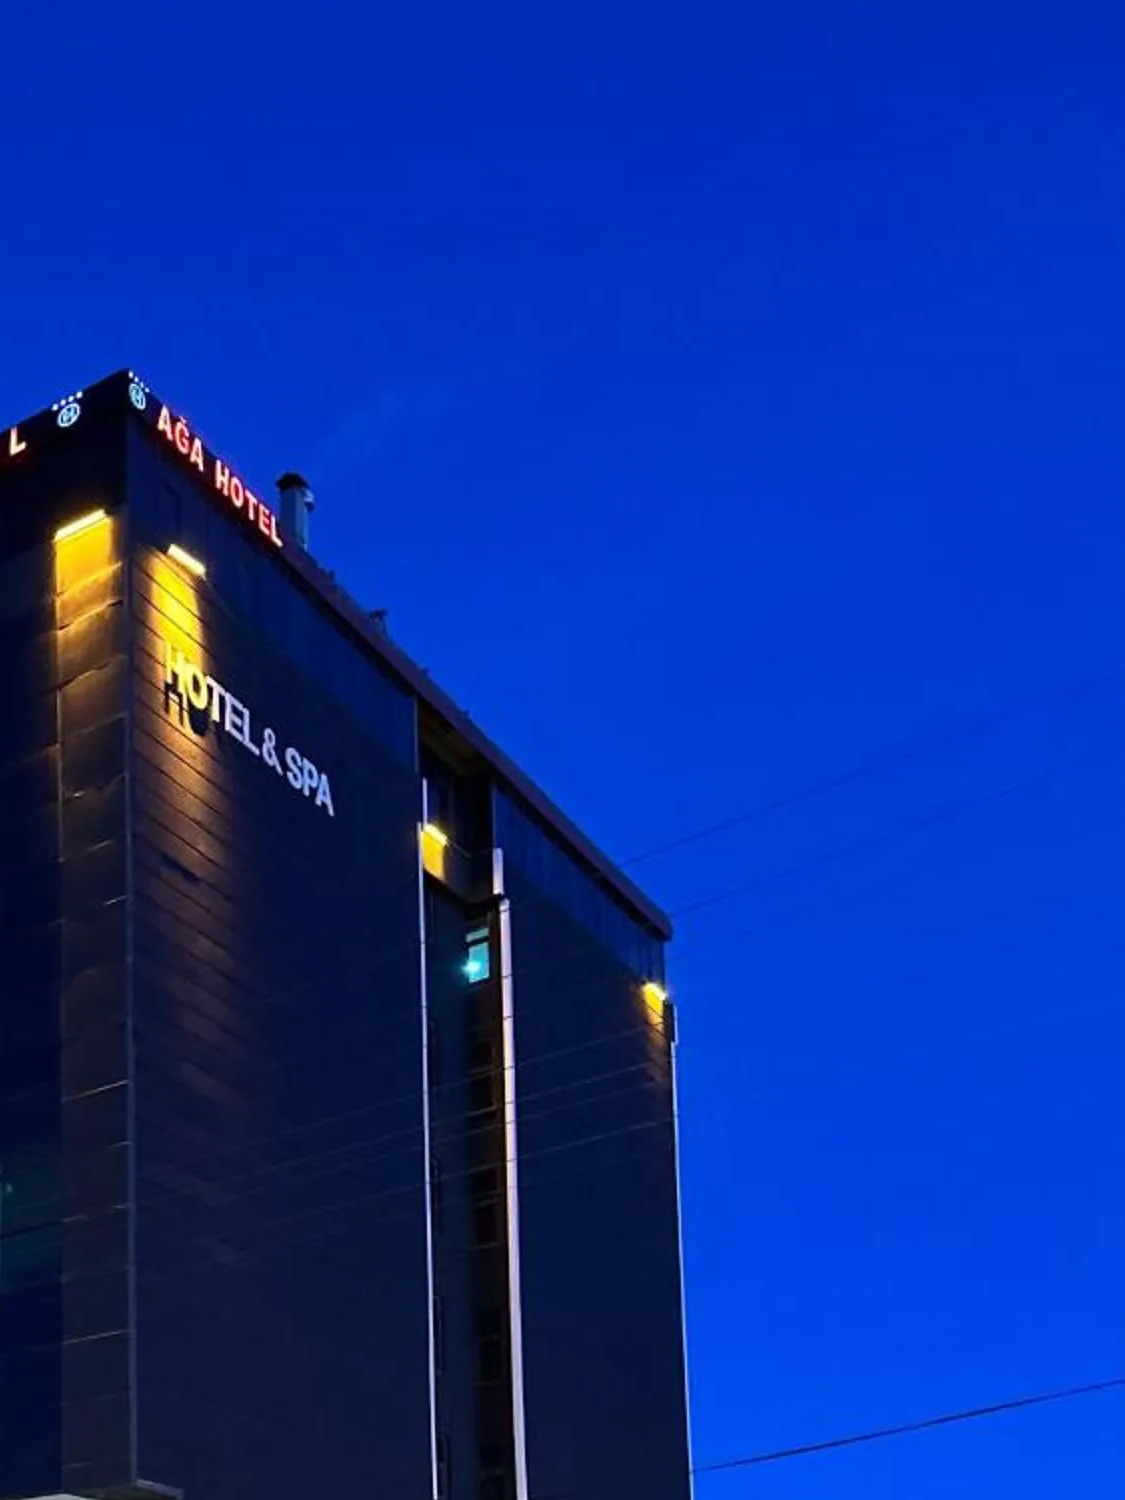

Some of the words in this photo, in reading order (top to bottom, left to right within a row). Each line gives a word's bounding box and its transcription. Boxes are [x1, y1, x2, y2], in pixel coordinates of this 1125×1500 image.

[158, 404, 203, 472] AĞA
[215, 459, 283, 547] HOTEL
[165, 640, 260, 756] HOTEL
[262, 728, 283, 776] &
[285, 747, 334, 817] SPA
